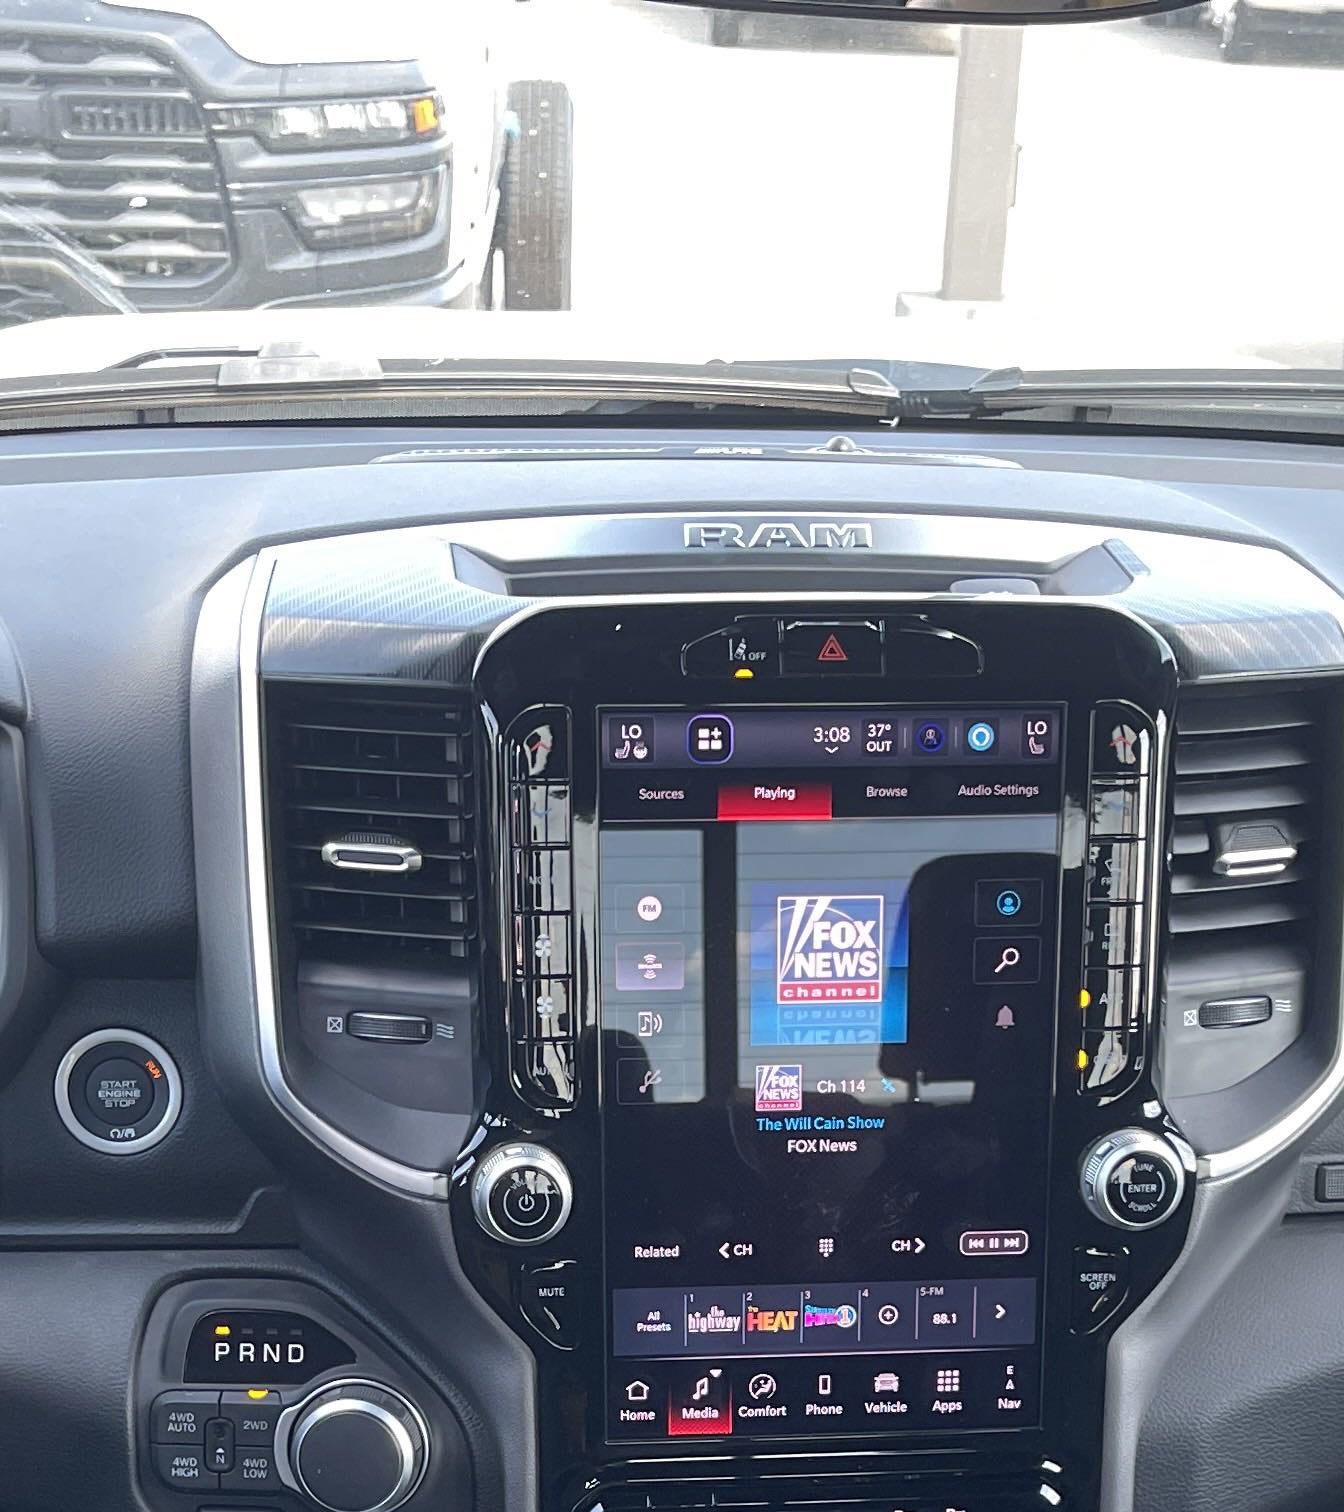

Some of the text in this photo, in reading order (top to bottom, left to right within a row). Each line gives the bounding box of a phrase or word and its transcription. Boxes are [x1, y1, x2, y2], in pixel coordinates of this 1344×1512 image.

[683, 522, 874, 549] RAM
[748, 652, 767, 661] OFF
[621, 724, 642, 739] LO
[867, 724, 892, 737] 37°
[1027, 721, 1048, 735] LO
[813, 727, 851, 743] 3:08
[866, 741, 892, 752] OUT
[638, 788, 685, 800] Sources
[754, 787, 796, 801] Playing
[866, 786, 908, 798] Browse
[958, 784, 1039, 798] Audio Settings
[642, 904, 657, 912] FM
[812, 920, 877, 949] FOX
[794, 951, 879, 979] NEWS
[783, 985, 876, 998] channel
[100, 1080, 138, 1088] START
[772, 1075, 798, 1087] FOX
[816, 1079, 866, 1093] Ch 114
[97, 1089, 142, 1098] ENGINE
[763, 1089, 799, 1100] NEWS
[756, 1116, 885, 1131] The Will Cain Show
[787, 1139, 858, 1153] FOX News
[1134, 1163, 1155, 1173] TUNE
[1128, 1184, 1157, 1193] ENTER
[1128, 1201, 1158, 1212] SCROLL
[634, 1245, 680, 1258] Related
[733, 1244, 753, 1256] CH
[891, 1240, 911, 1251] CH
[1080, 1273, 1116, 1282] SCREEN
[1089, 1281, 1107, 1290] OFF
[539, 1287, 565, 1297] MUTE
[689, 1293, 694, 1303] 1
[746, 1292, 753, 1301] 2
[804, 1290, 811, 1299] 3
[862, 1288, 869, 1297] 4
[647, 1311, 660, 1320] All
[710, 1305, 725, 1317] the
[688, 1312, 741, 1333] highway
[746, 1311, 799, 1333] HEAT
[932, 1313, 957, 1324] 88.1
[637, 1323, 672, 1332] Presets
[214, 1343, 304, 1362] P R N D
[806, 1402, 843, 1415] Phone
[864, 1401, 908, 1413] Vehicle
[932, 1400, 963, 1414] Apps
[998, 1398, 1022, 1410] Nav
[620, 1409, 656, 1421] Home
[682, 1407, 719, 1419] Media
[738, 1404, 787, 1418] Comfort
[169, 1412, 195, 1423] 4WD
[167, 1422, 196, 1433] AUTO
[243, 1420, 268, 1431] 2WD
[172, 1457, 198, 1467] 4WD
[216, 1454, 225, 1464] N
[242, 1458, 268, 1468] 4WD
[171, 1467, 199, 1478] HIGH
[243, 1469, 267, 1479] LOW
